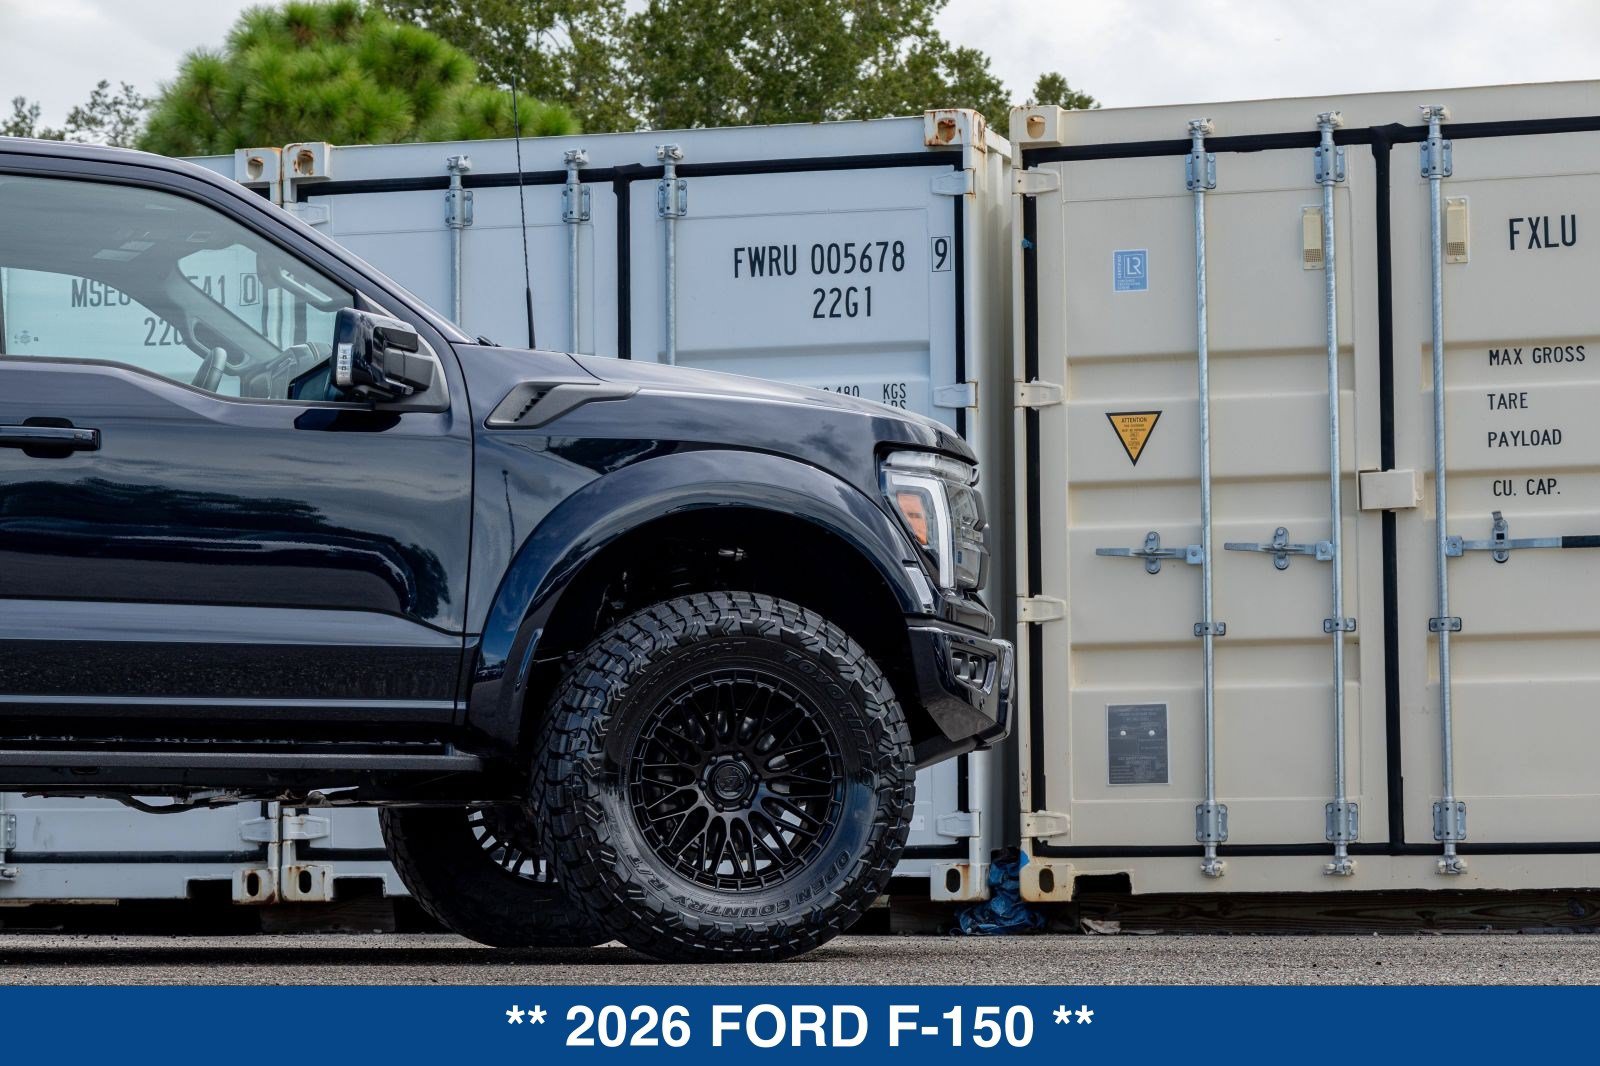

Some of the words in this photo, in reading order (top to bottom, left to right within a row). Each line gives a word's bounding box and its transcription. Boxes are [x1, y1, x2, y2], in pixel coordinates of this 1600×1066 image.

[1509, 214, 1577, 250] FXLU
[733, 244, 797, 278] FWRU
[810, 240, 905, 275] 005678
[933, 237, 949, 270] 9
[1126, 256, 1142, 275] LR
[812, 285, 872, 318] 22G1
[1488, 348, 1523, 366] MAX
[1532, 345, 1586, 364] GROSS
[883, 382, 907, 400] KGS
[1487, 392, 1529, 411] TARE
[1487, 428, 1562, 448] PAYLOAD
[1493, 479, 1517, 497] CU.
[1526, 478, 1561, 496] CAP.
[783, 650, 846, 700] TOYO
[626, 853, 669, 892] R/T
[796, 850, 851, 904] OPEN
[671, 894, 791, 918] COUNTRY
